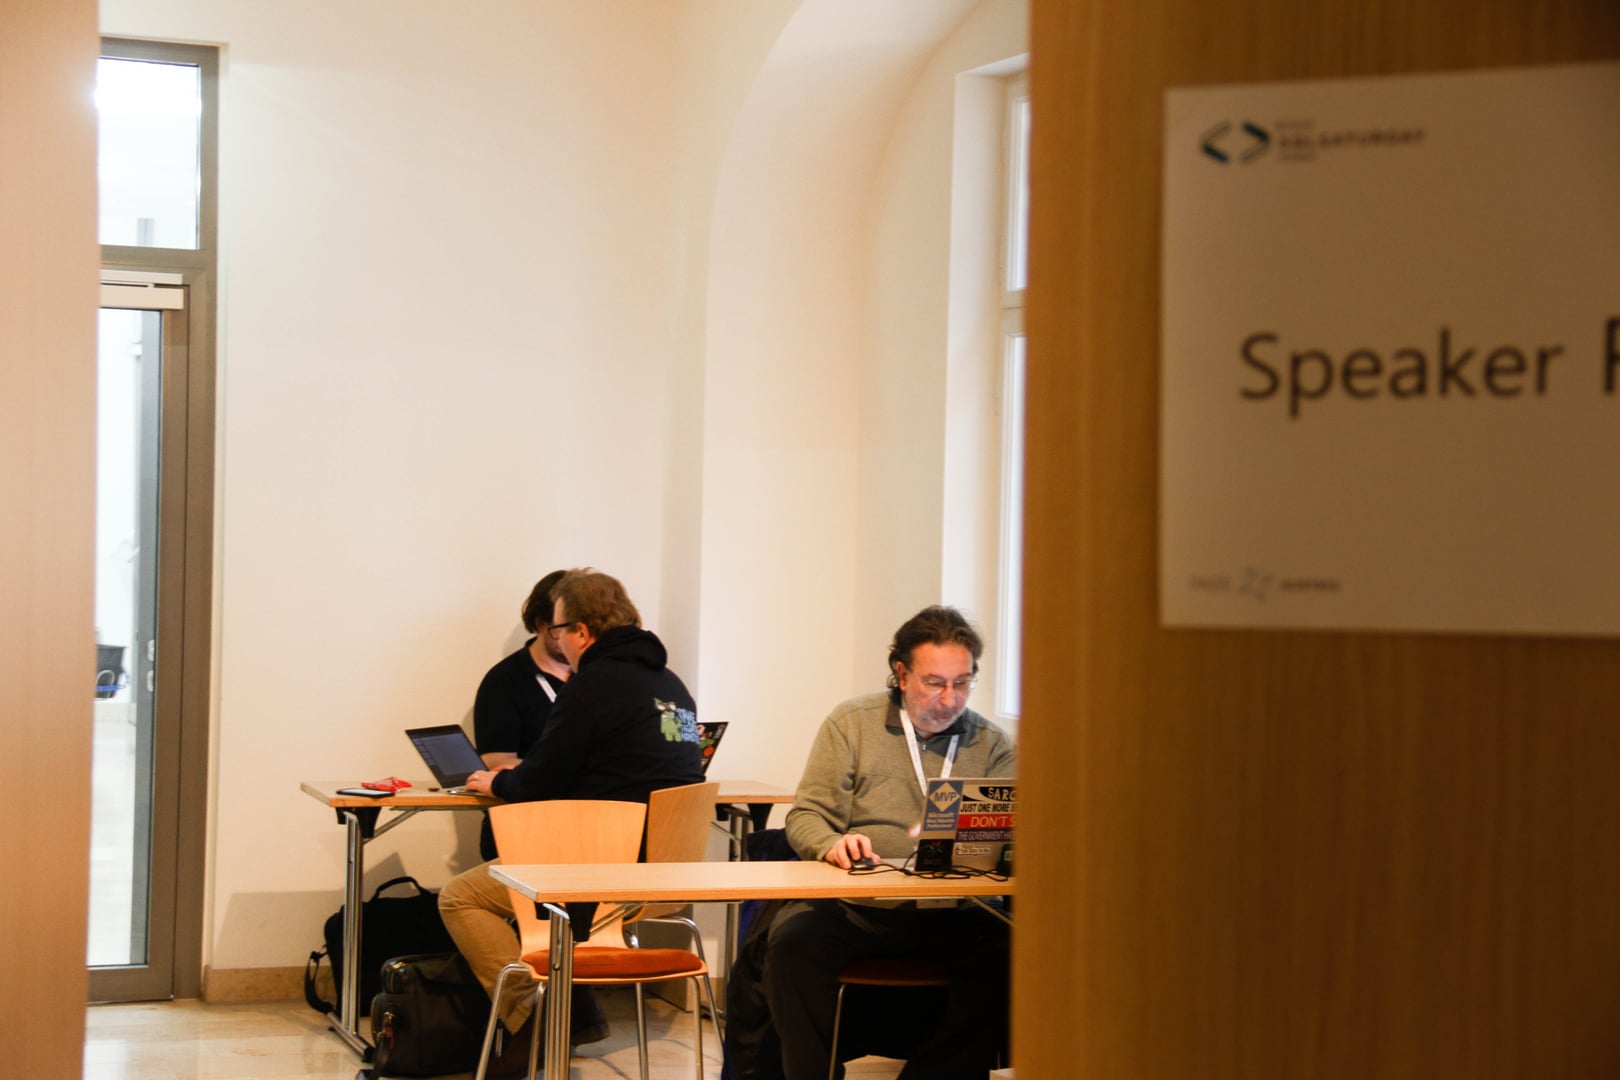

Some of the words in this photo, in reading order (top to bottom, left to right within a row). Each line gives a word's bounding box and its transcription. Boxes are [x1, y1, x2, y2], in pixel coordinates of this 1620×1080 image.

[1239, 326, 1566, 420] Speaker
[934, 791, 957, 802] MVP
[960, 803, 976, 813] JUST
[977, 803, 991, 813] ONE
[992, 803, 1009, 813] MORE
[970, 816, 1009, 828] DON'T
